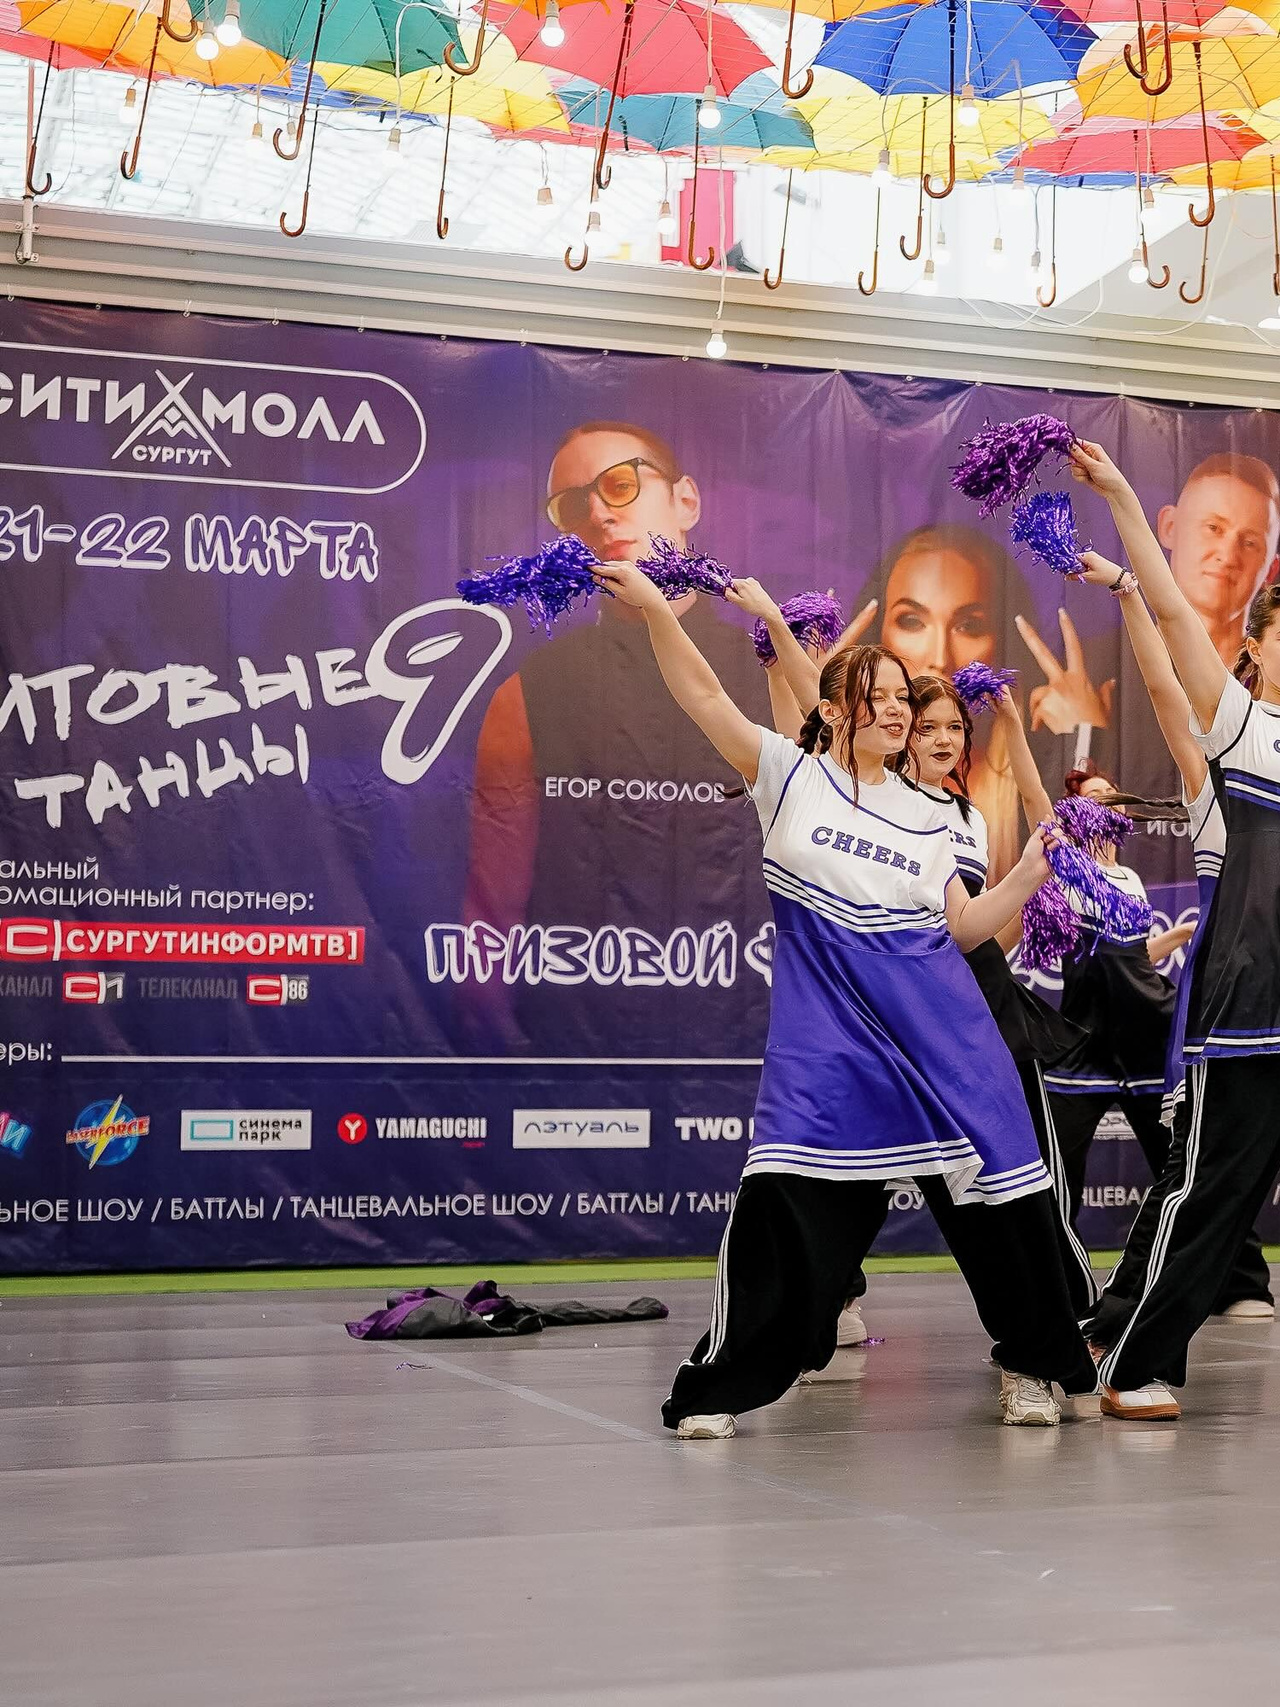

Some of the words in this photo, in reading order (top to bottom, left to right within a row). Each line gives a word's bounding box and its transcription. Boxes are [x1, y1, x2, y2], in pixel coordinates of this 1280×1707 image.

[202, 387, 386, 446] МОЛЛ
[131, 444, 213, 467] СУРГУТ
[184, 513, 380, 583] МАРТА
[14, 723, 310, 828] ТАНЦЫ
[545, 776, 602, 799] ЕГОР
[607, 778, 726, 804] СОКОЛОВ
[810, 825, 922, 877] CHEERS
[190, 889, 315, 916] партнер:
[424, 920, 738, 988] ПРИЗОВОЙ
[138, 977, 238, 1000] ТЕЛЕКАНАЛ
[239, 1118, 303, 1131] синема
[239, 1130, 282, 1144] парк
[375, 1117, 488, 1139] YAMAGUCHI
[674, 1116, 743, 1141] TWO
[77, 1199, 144, 1222] ШОУ
[170, 1197, 265, 1221] БАТТЛЫ
[290, 1194, 486, 1221] ТАНЦЕВАЛЬНОЕ
[492, 1193, 554, 1216] ШОУ
[577, 1192, 664, 1215] БАТТЛЫ
[686, 1191, 737, 1213] ТАН
